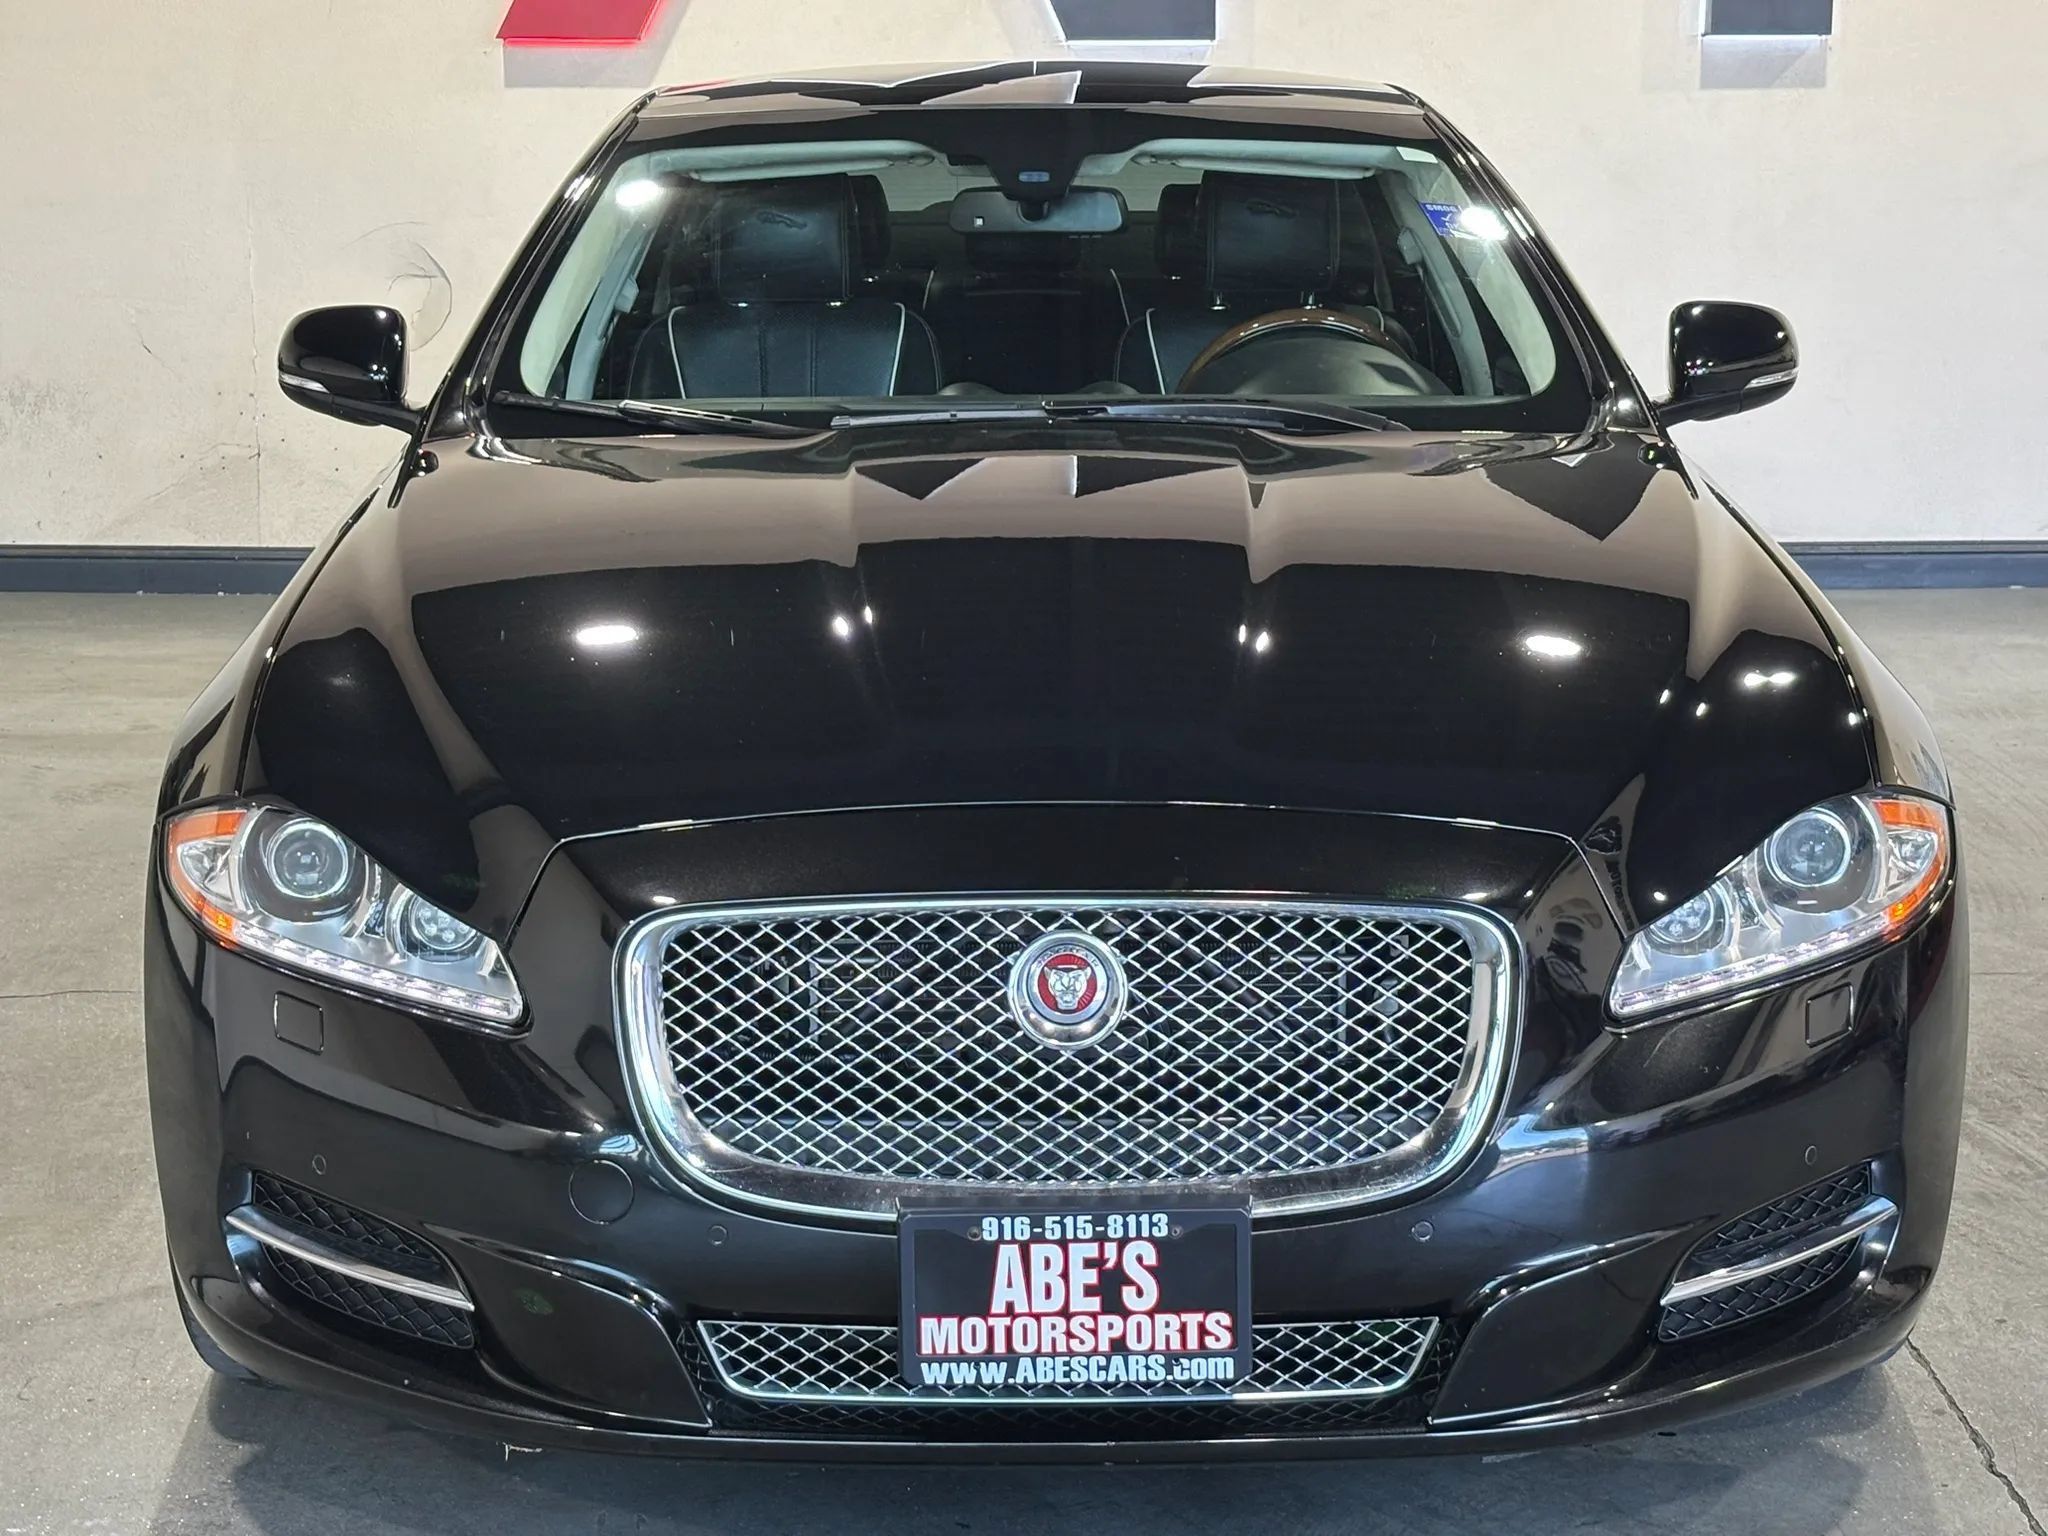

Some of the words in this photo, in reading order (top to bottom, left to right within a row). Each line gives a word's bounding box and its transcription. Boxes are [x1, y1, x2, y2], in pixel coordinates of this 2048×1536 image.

[982, 1213, 1169, 1241] 916-515-8113
[991, 1240, 1159, 1313] ABE'S
[920, 1312, 1233, 1355] MOTORSPORTS
[921, 1355, 1234, 1384] www.ABESCARS.com
